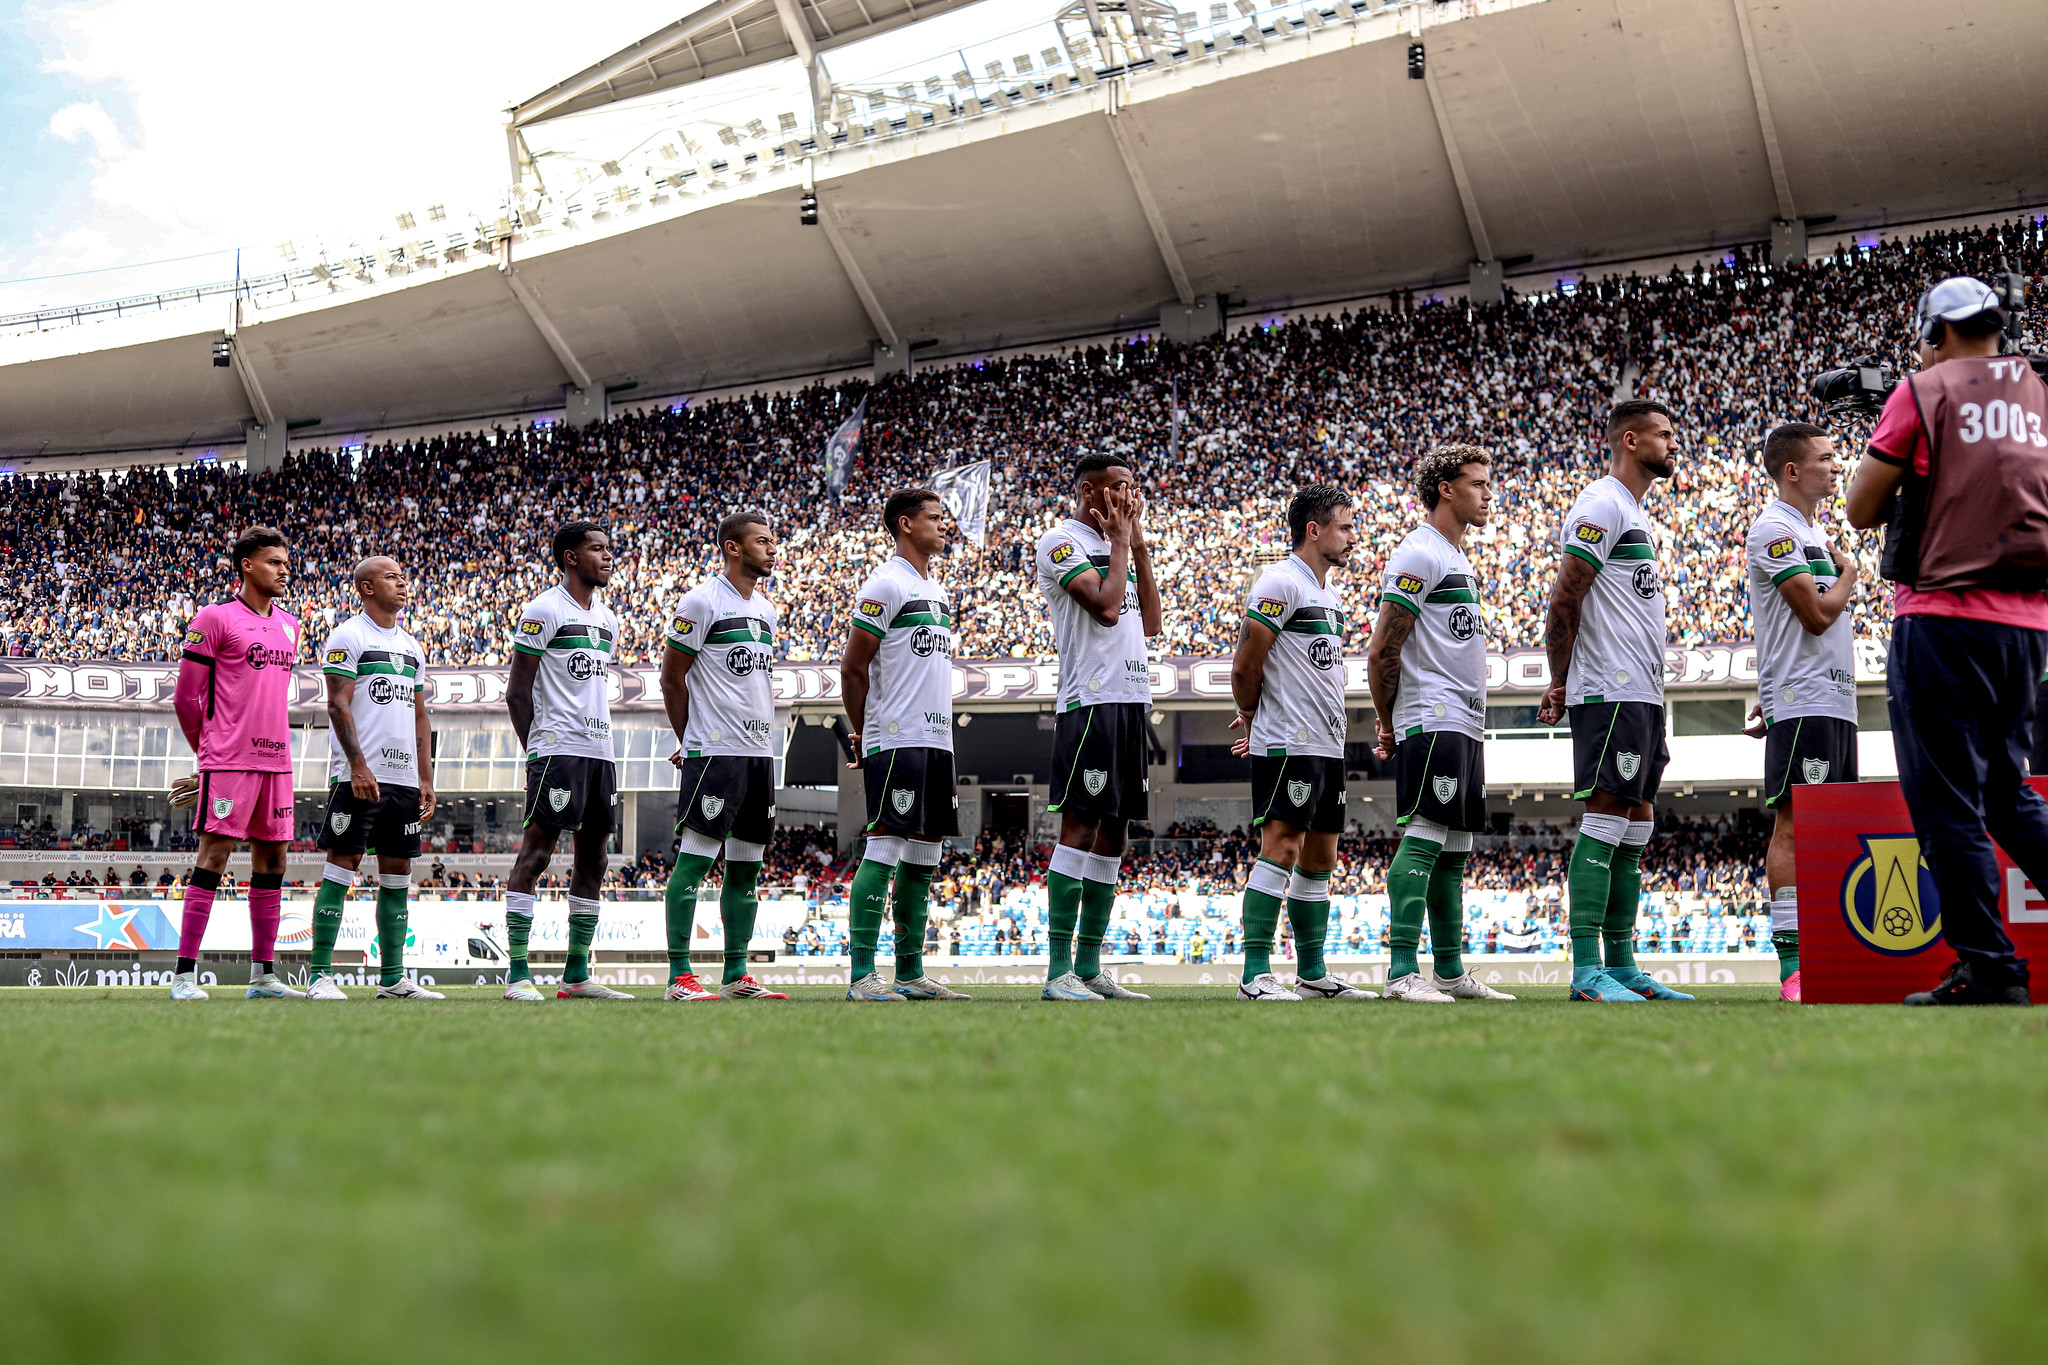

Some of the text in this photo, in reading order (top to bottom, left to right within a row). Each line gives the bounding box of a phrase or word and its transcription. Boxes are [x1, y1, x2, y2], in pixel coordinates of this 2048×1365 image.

[1988, 361, 2025, 382] TV
[1959, 399, 2047, 447] 3003
[1578, 526, 1601, 542] BH
[1053, 545, 1074, 564] BH
[1771, 540, 1793, 558] BH
[1398, 577, 1421, 593] BH
[861, 602, 881, 616] BH
[1260, 602, 1283, 616] BH
[674, 619, 691, 633] BH
[187, 631, 203, 643] BH
[328, 652, 345, 663] BH
[1125, 659, 1149, 676] Villa
[251, 738, 286, 752] Village
[258, 750, 279, 759] Resort
[387, 762, 409, 771] Resort
[318, 908, 341, 918] AFC
